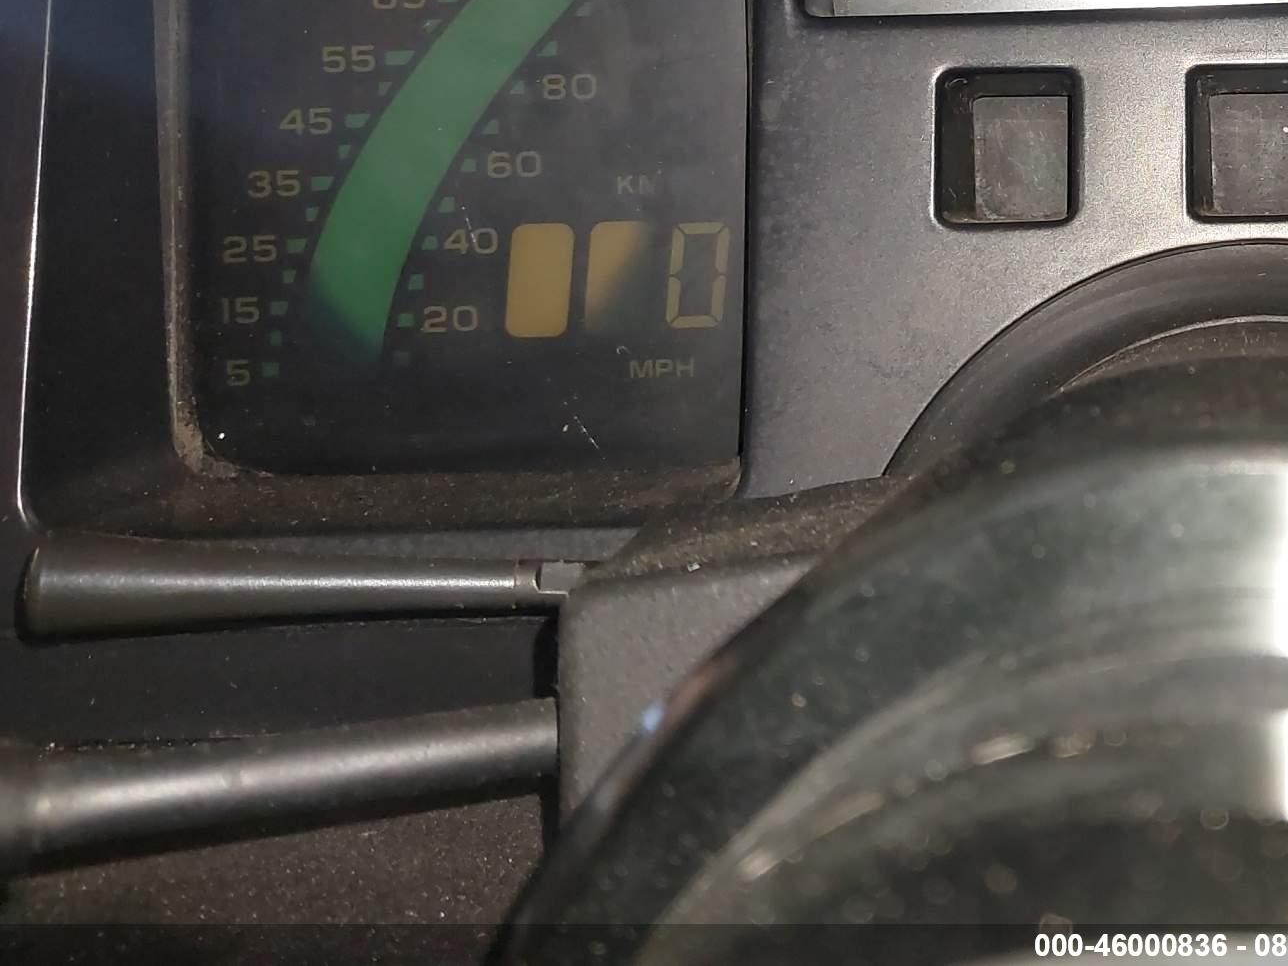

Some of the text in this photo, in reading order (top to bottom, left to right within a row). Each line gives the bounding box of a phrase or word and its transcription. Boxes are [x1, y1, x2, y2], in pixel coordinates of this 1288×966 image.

[321, 45, 376, 73] 55
[542, 73, 598, 100] 80
[279, 108, 333, 135] 45
[486, 151, 542, 179] 60
[247, 170, 301, 198] 35
[222, 235, 278, 263] 25
[443, 228, 499, 256] 40
[666, 221, 730, 330] 0
[222, 297, 260, 325] 15
[422, 305, 478, 333] 20
[226, 360, 252, 386] 5
[629, 359, 695, 380] MPH
